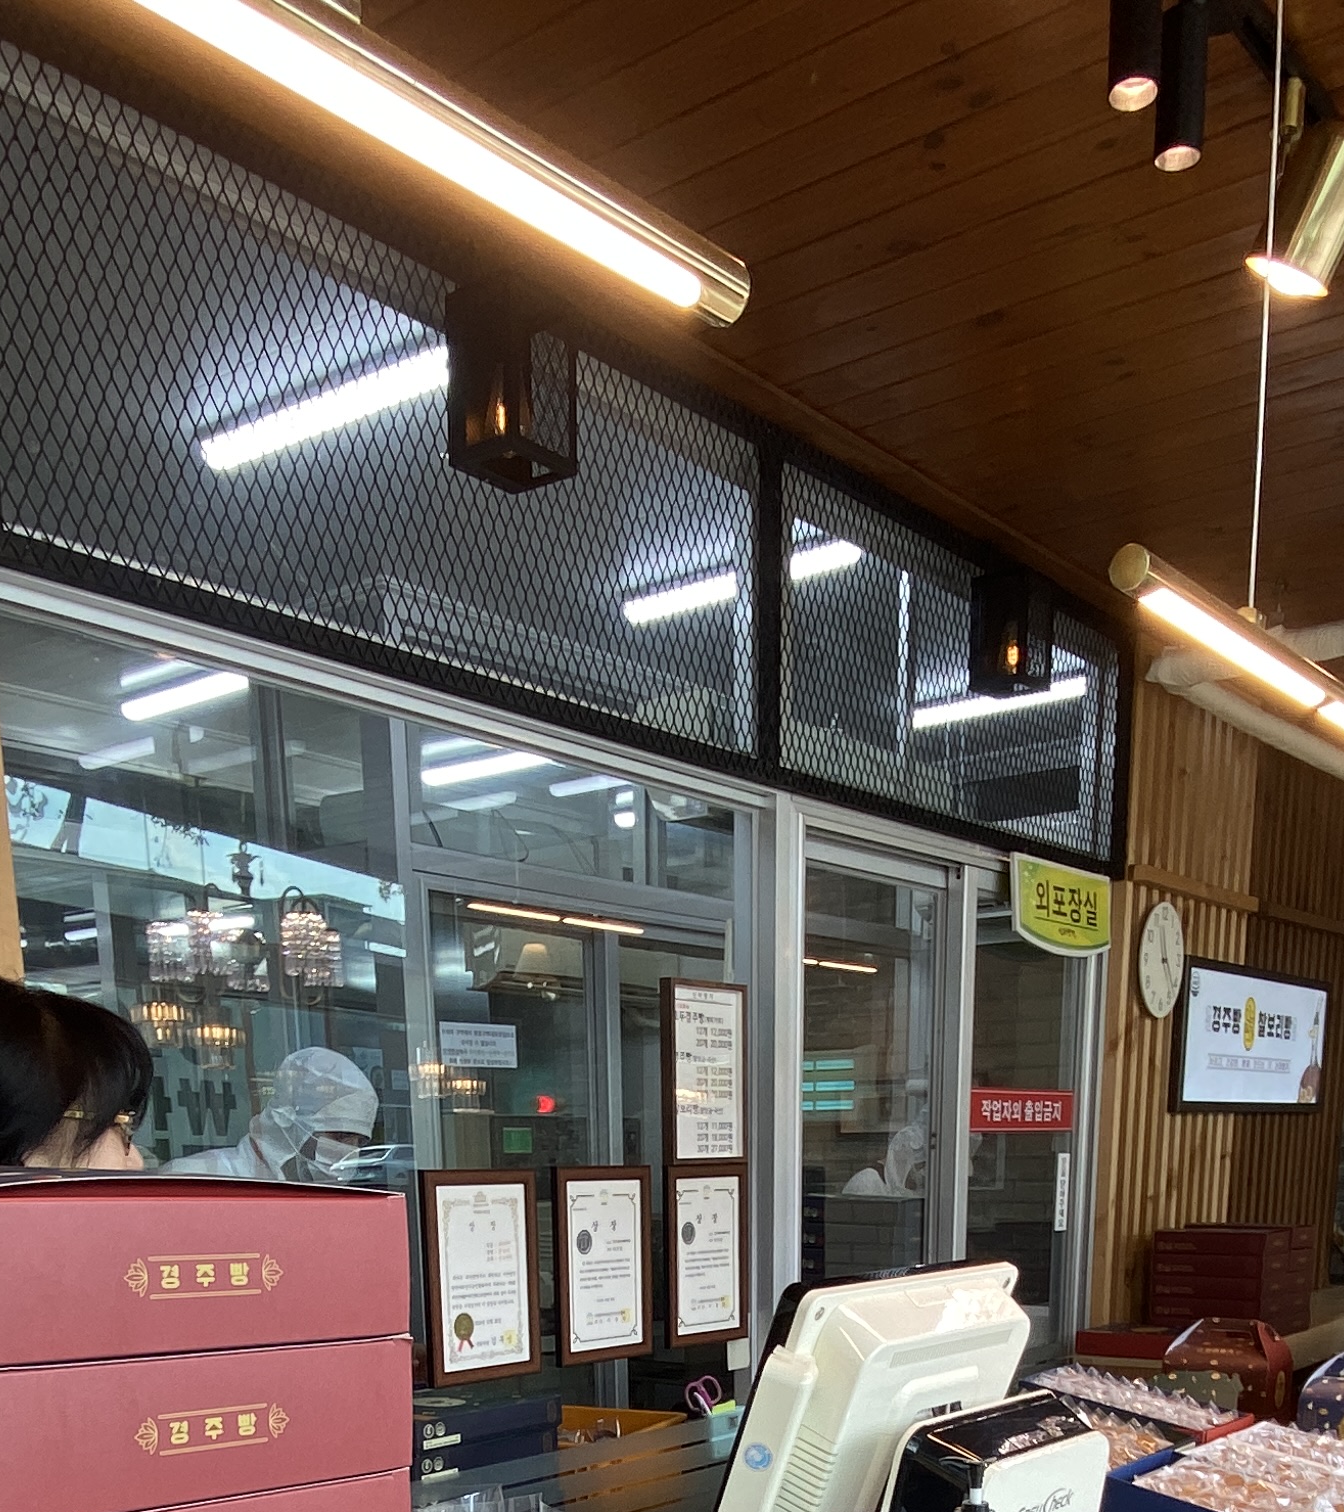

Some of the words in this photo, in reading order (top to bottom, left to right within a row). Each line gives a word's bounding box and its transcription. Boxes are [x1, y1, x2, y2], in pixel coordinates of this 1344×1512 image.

[1036, 879, 1098, 927] 외포장실
[1211, 1005, 1242, 1035] 경주빵
[981, 1099, 1022, 1122] 작업자외
[1024, 1099, 1063, 1122] 출입금지
[161, 1263, 248, 1288] 경주빵
[170, 1414, 256, 1443] 경주빵
